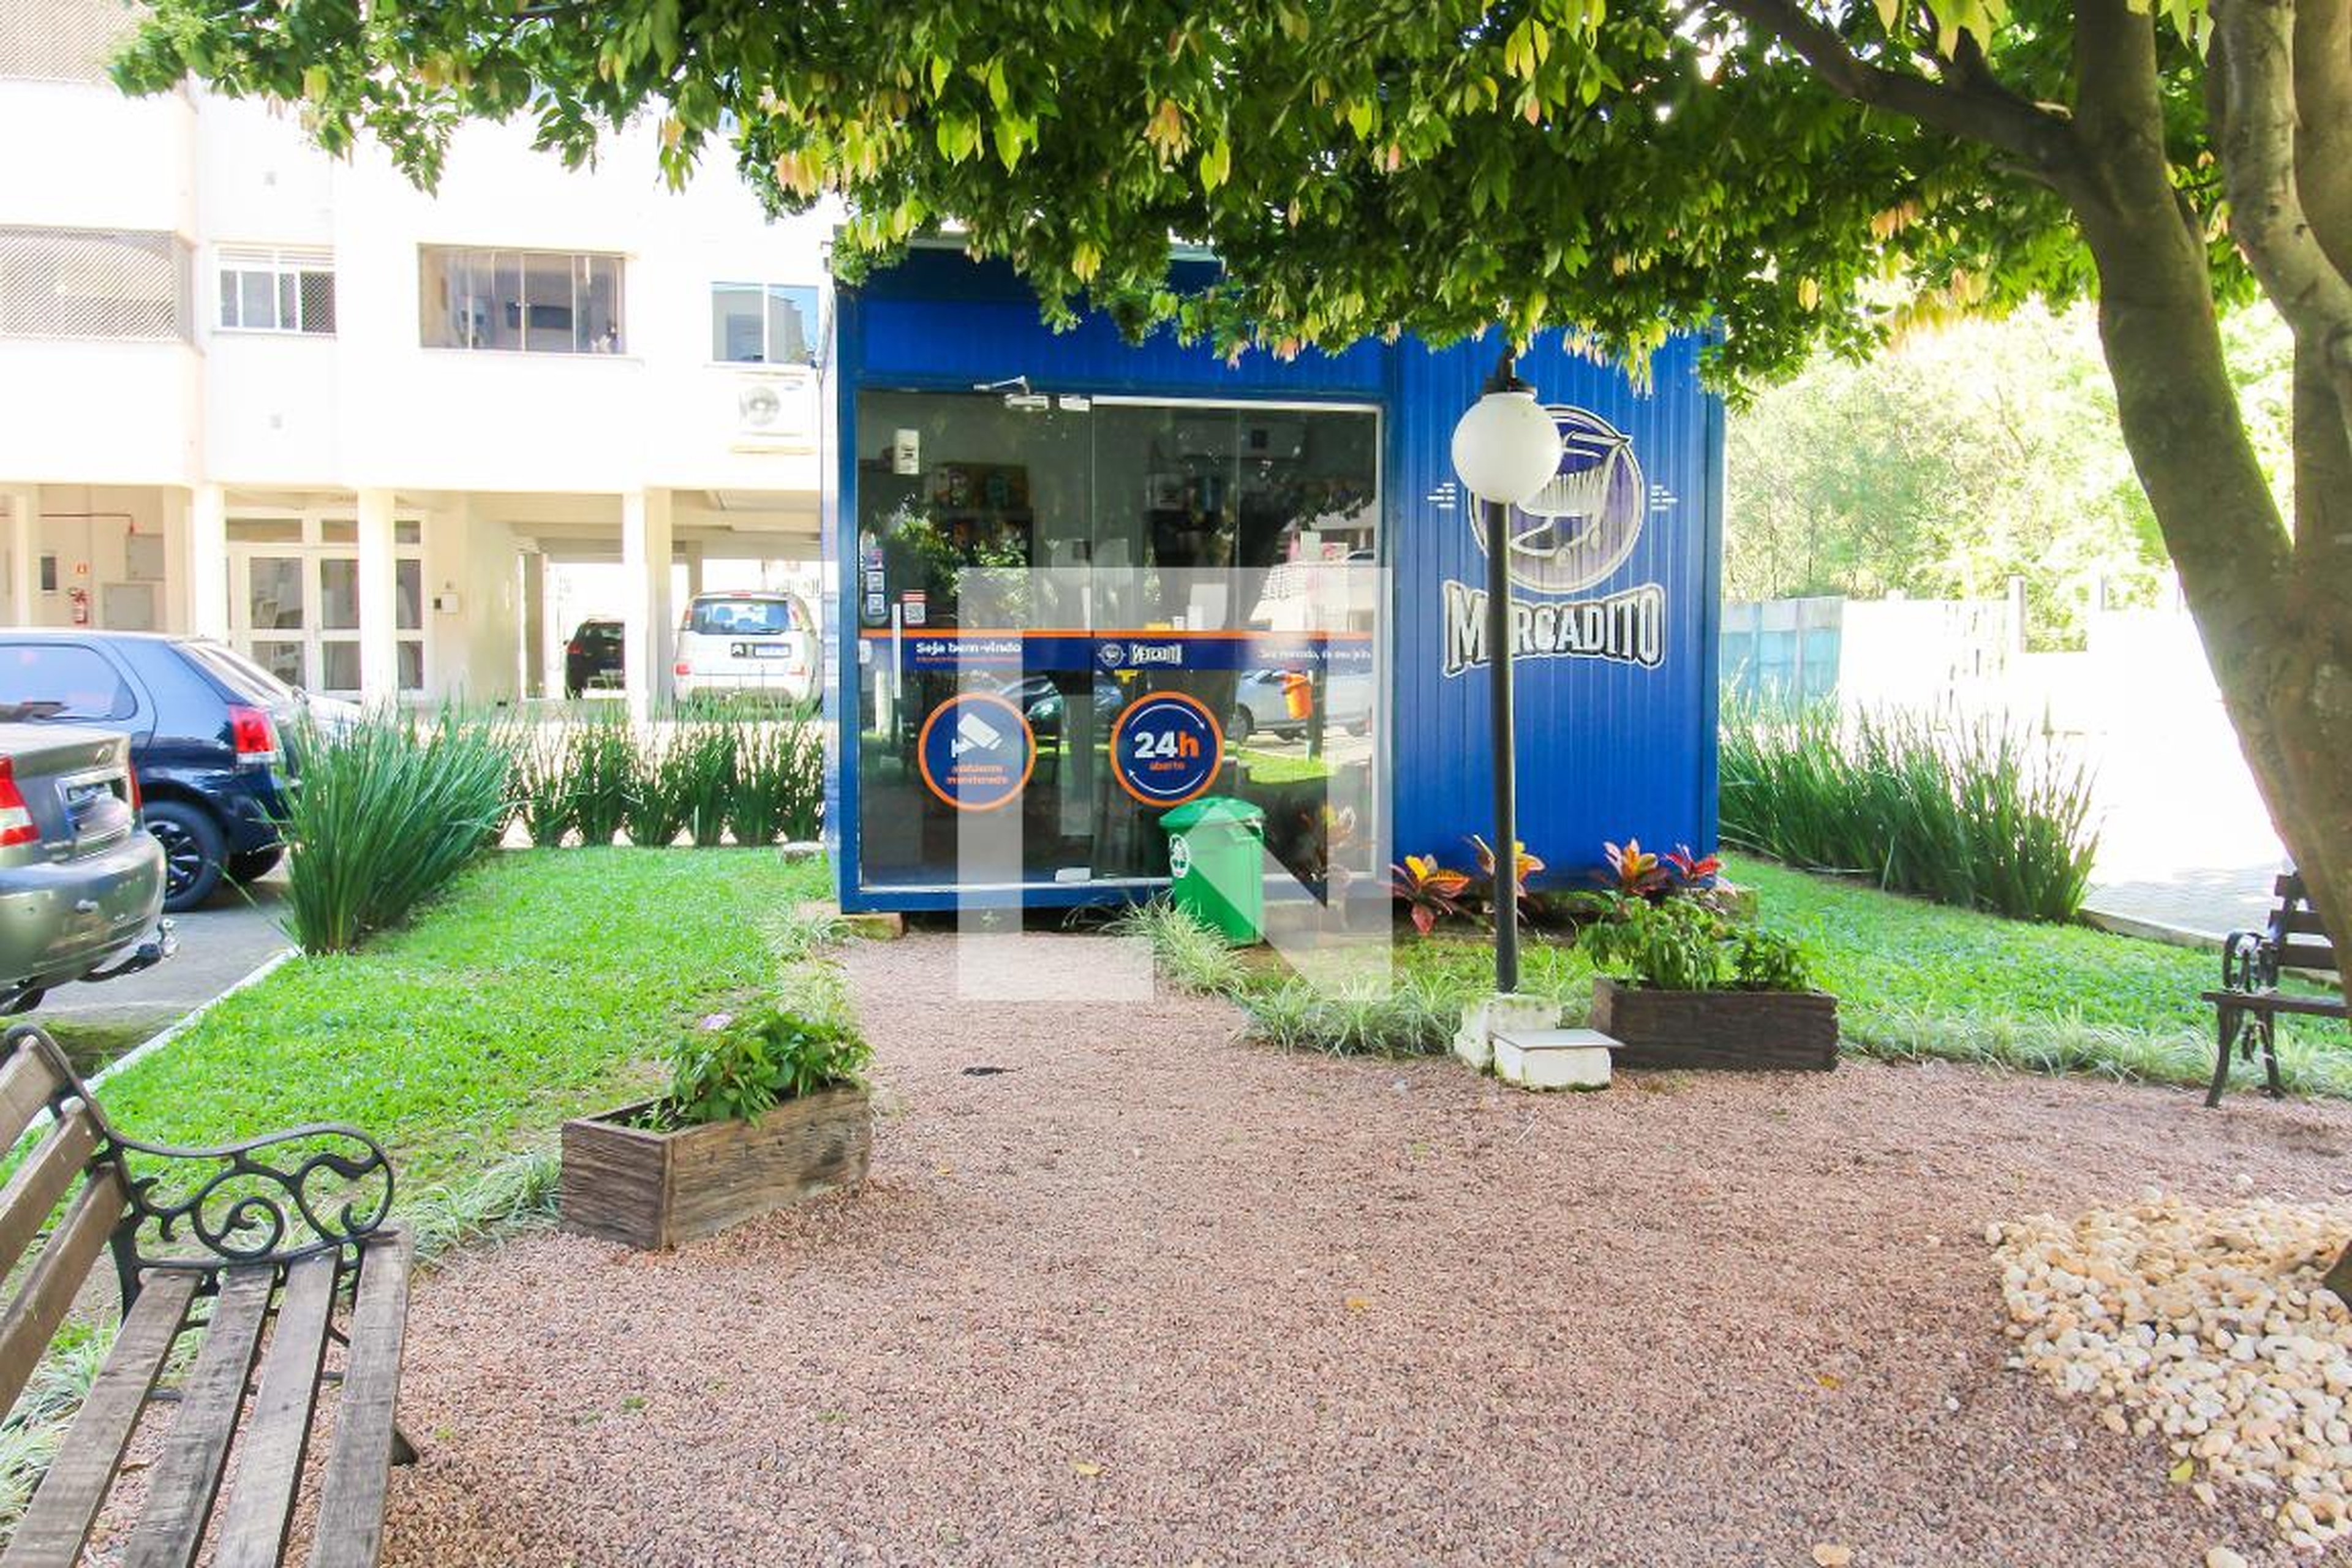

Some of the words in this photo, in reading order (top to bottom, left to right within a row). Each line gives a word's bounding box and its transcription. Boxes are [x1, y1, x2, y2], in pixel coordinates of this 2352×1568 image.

[1444, 579, 1665, 677] MRCADITO
[916, 641, 945, 655] Seja
[1134, 731, 1199, 758] 24h
